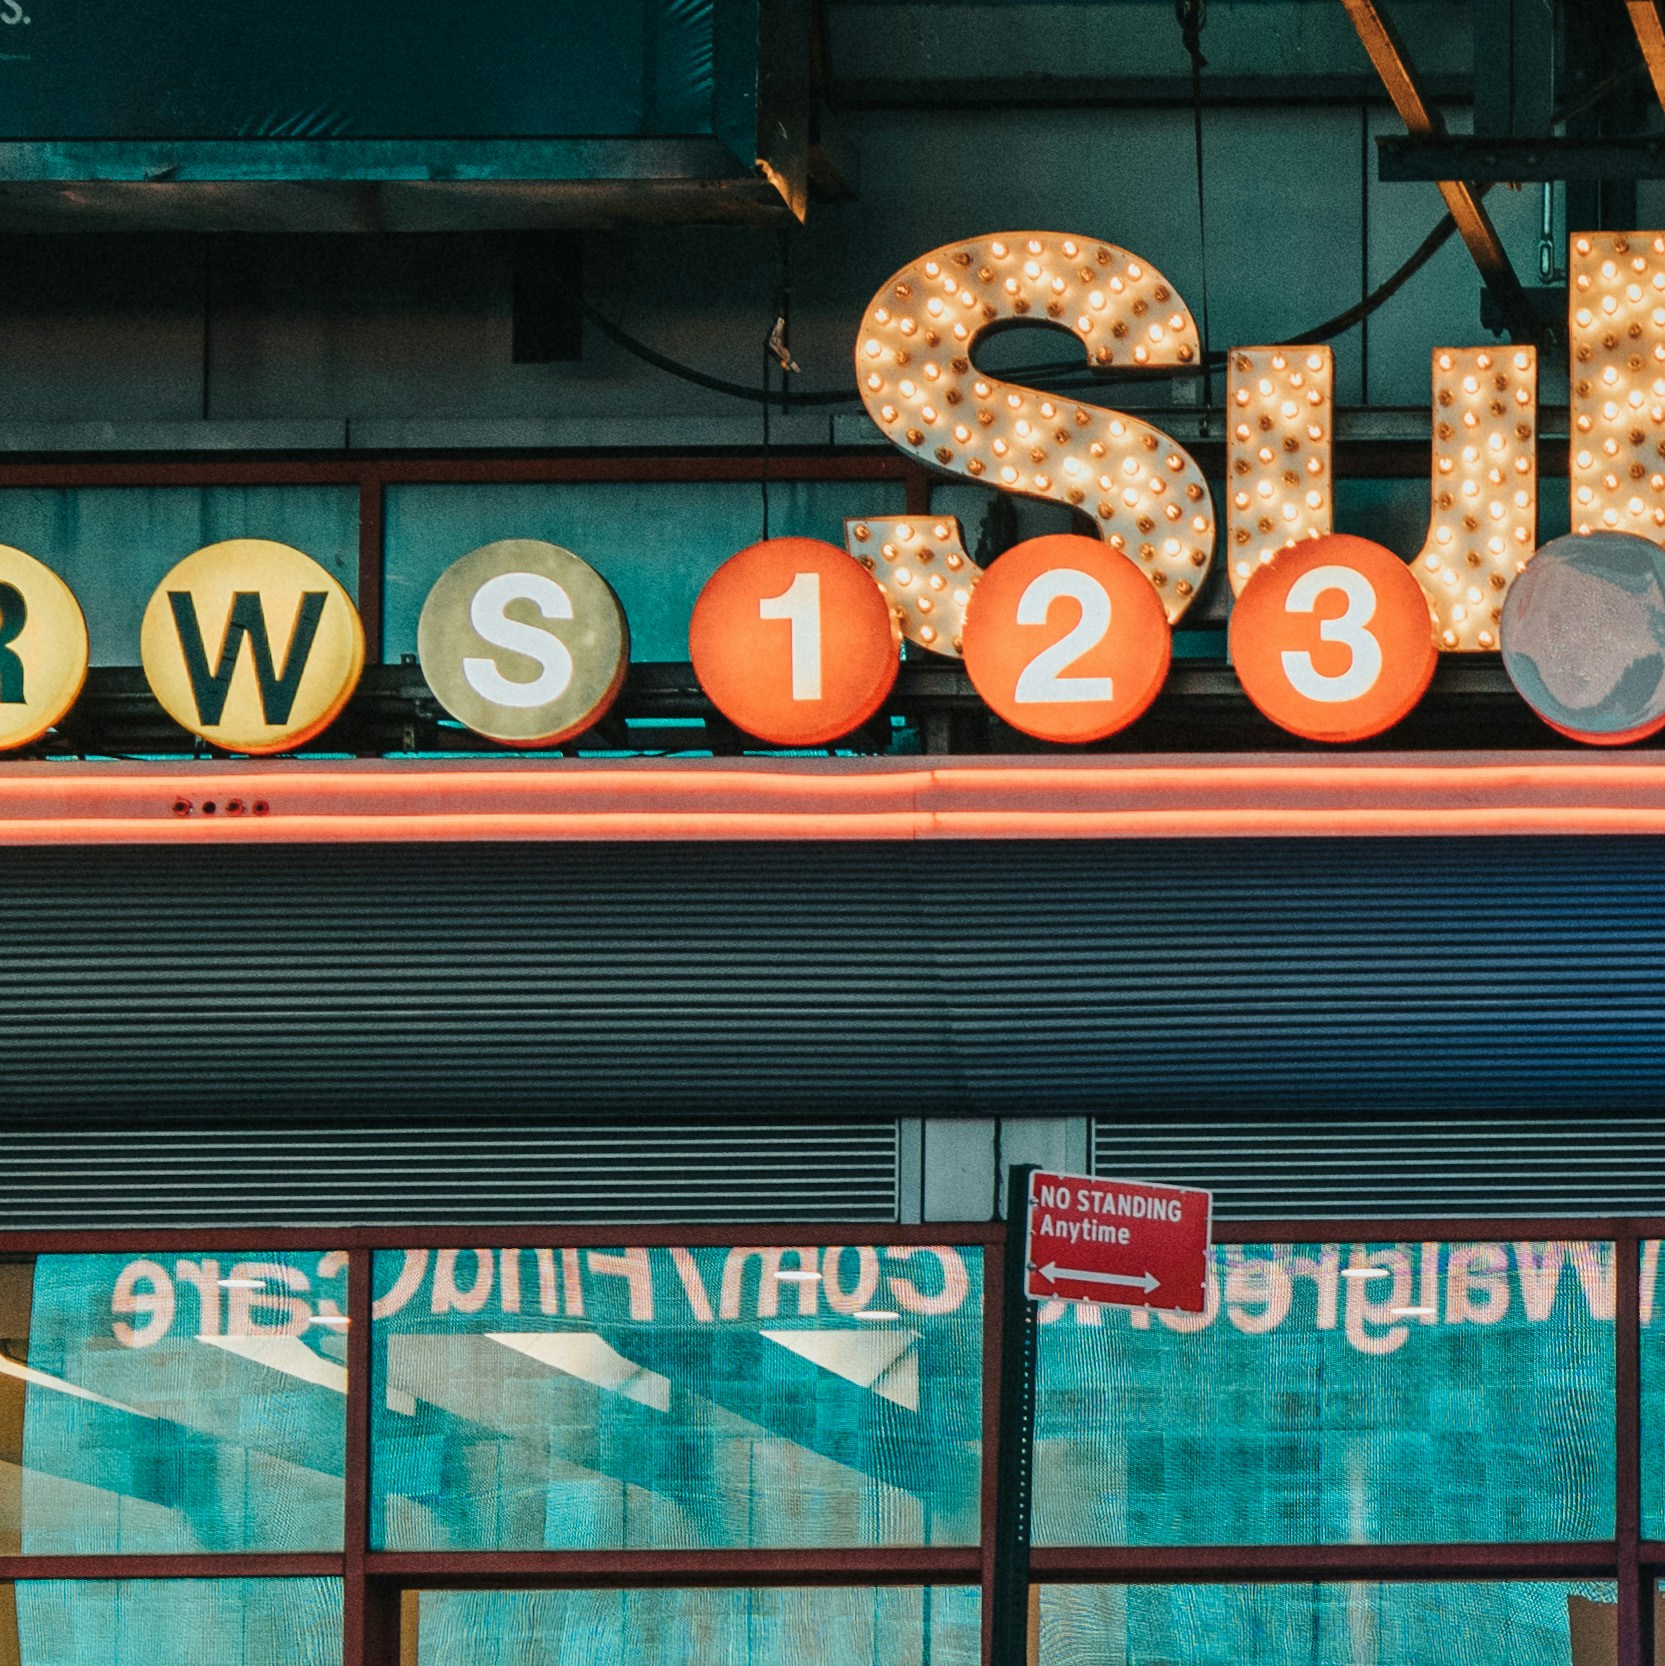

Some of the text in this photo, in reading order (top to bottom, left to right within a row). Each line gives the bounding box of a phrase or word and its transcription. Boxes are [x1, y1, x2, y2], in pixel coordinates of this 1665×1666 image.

[167, 591, 328, 726] W
[463, 572, 572, 708] S
[759, 573, 822, 701] 1
[1013, 568, 1115, 702] 2
[1281, 565, 1384, 702] 3
[1040, 1185, 1183, 1223] NO STANDING
[1040, 1214, 1131, 1245] Anytime
